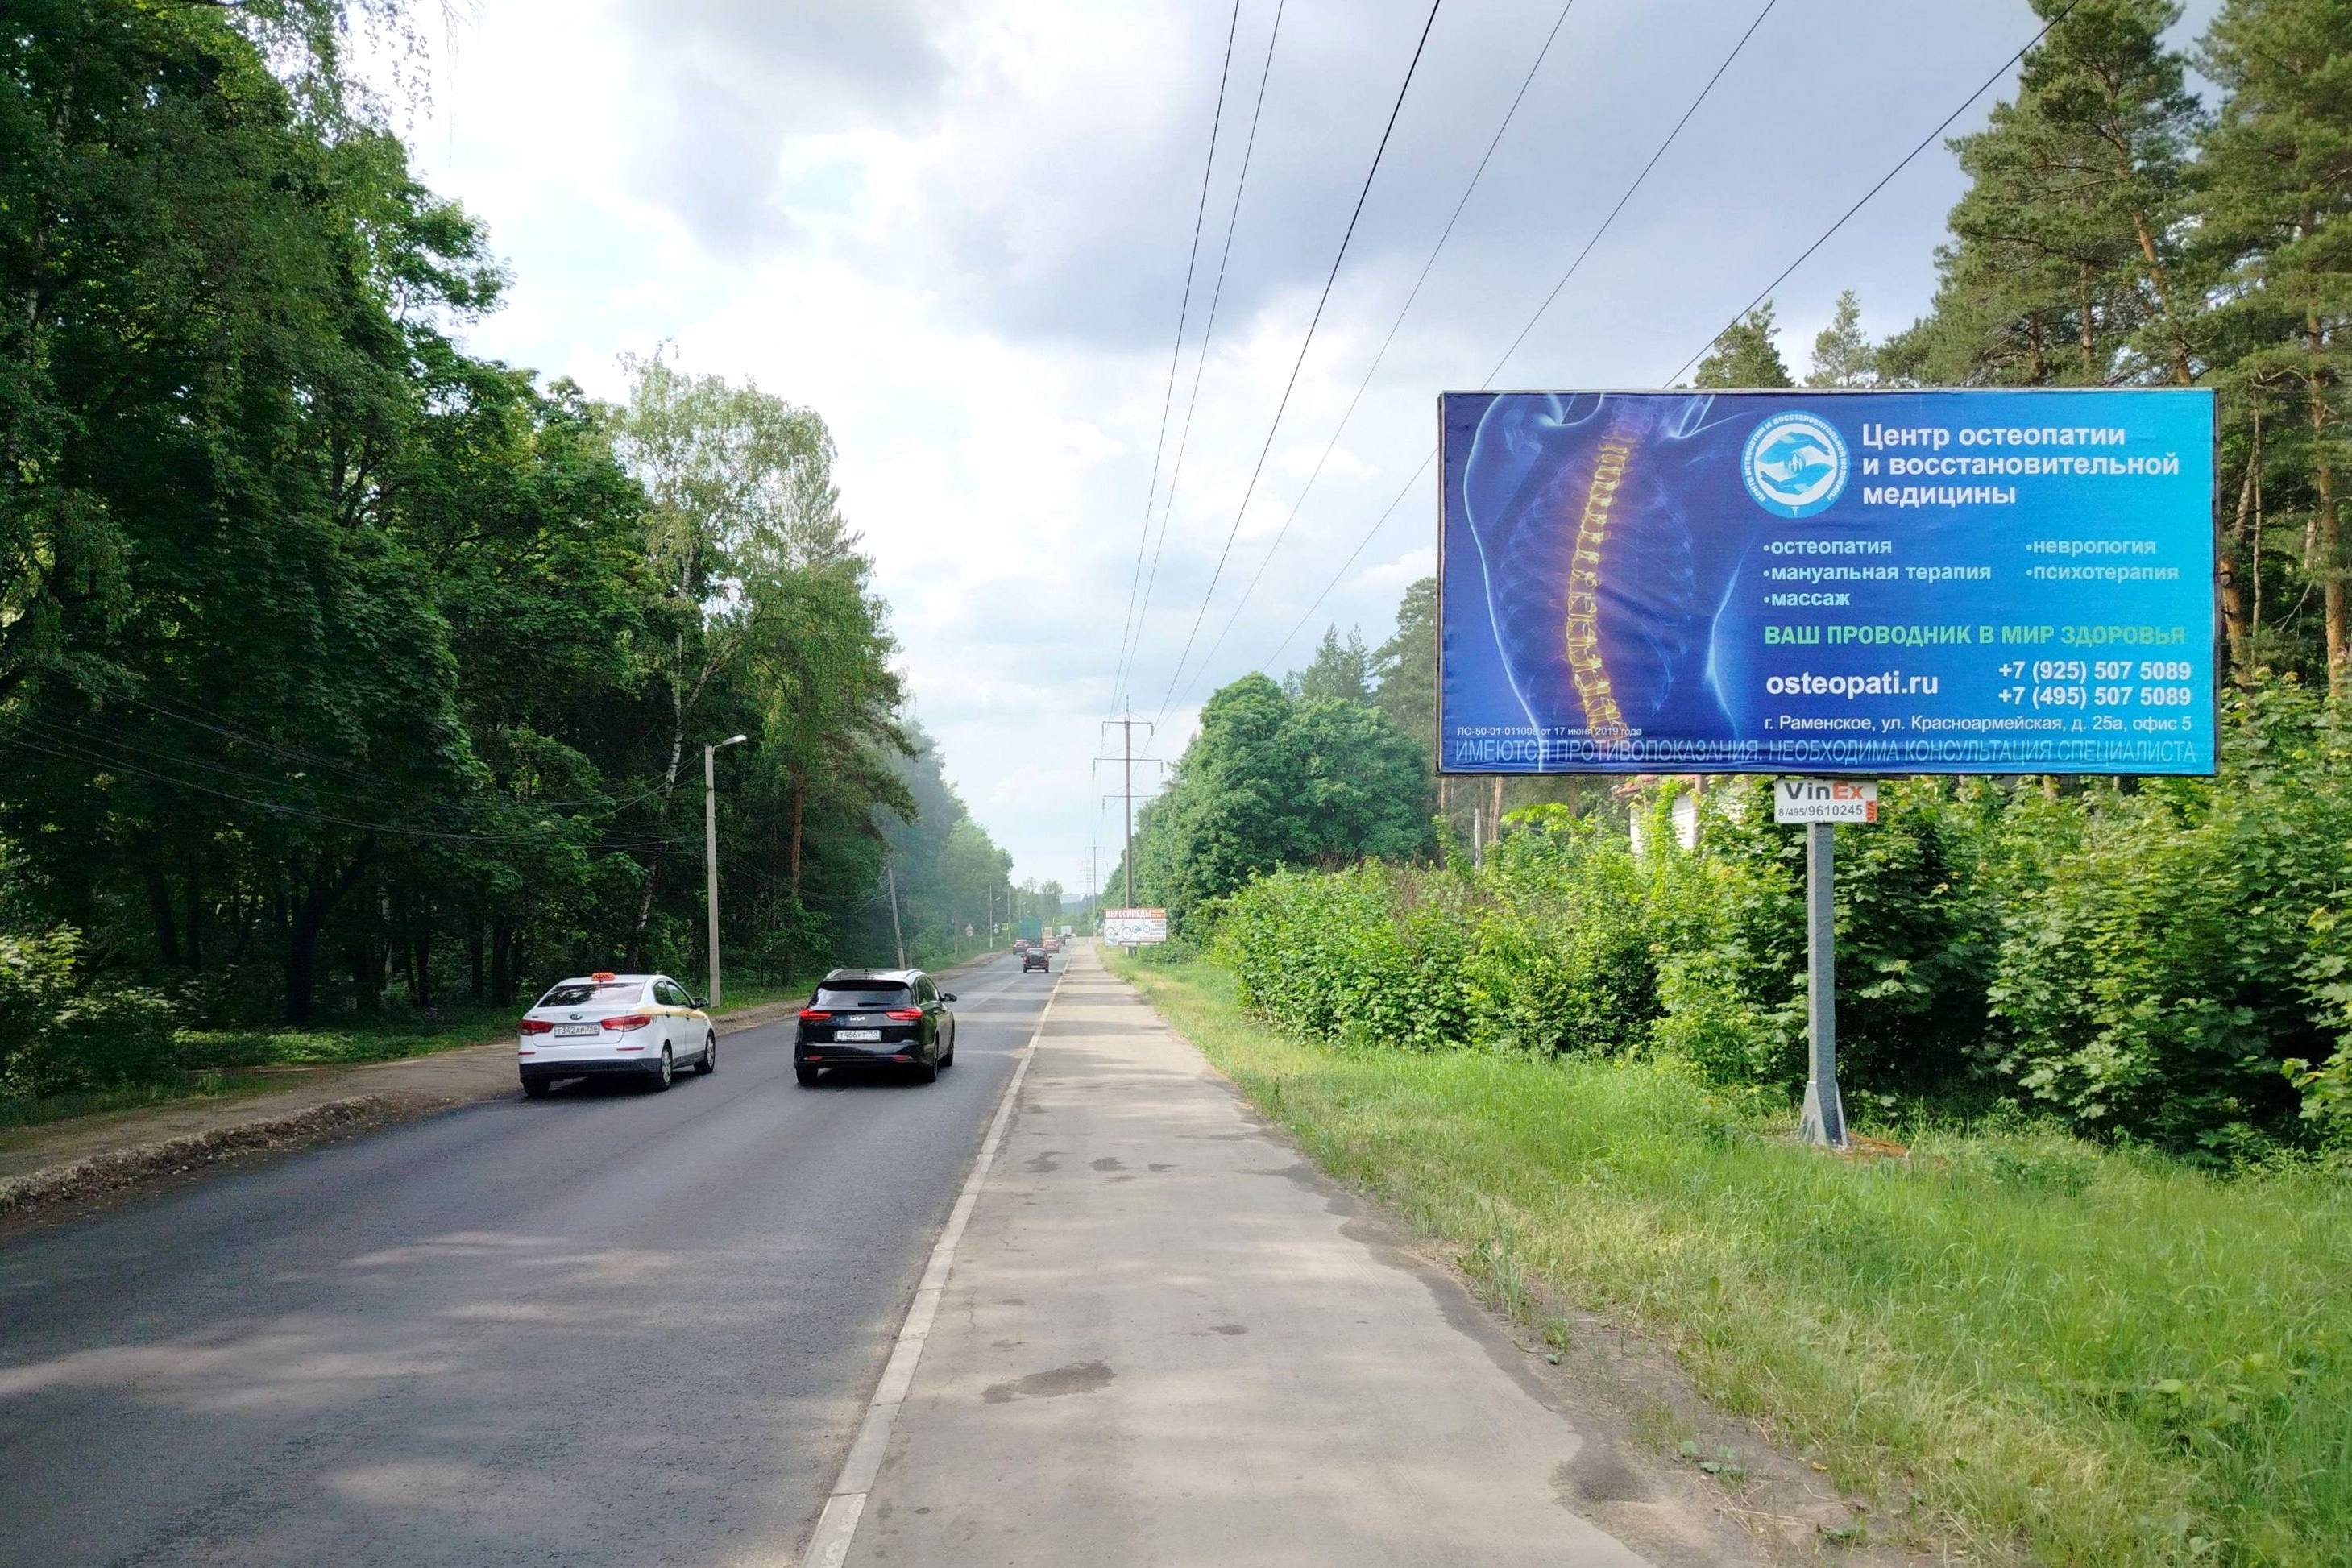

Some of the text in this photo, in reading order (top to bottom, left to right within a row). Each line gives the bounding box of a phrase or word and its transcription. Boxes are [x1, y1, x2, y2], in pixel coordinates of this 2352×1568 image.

[1863, 423, 2126, 451] Центр остеопатии
[1863, 451, 2180, 475] и восстановительной
[1863, 487, 2016, 508] медицины
[1771, 541, 1893, 554] остеопатия
[2033, 541, 2156, 558] неврология
[1771, 566, 1992, 584] мануальная терапия
[2033, 566, 2180, 584] психотерапия
[1771, 593, 1851, 606] массаж
[1765, 625, 2186, 647] ВАШ ПРОВОДНИК В МИР ЗДОРОВЬЯ
[1998, 661, 2192, 684] +7 (925) 507 5089
[1765, 670, 1939, 699] osteopati.ru
[1998, 687, 2192, 710] +7 (495) 507 5089
[1554, 727, 1565, 736] 17
[1595, 727, 1620, 736] 2019
[1621, 728, 1643, 737] года
[1765, 715, 2192, 734] г. Раменское, ул. Красноармейская, д. 25а, офис 5
[1455, 740, 2196, 766] ИМЕЮТСЯ ПРОТИВОПОКАЗАНИЯ. НЕОБХОДИМА КОНСУЛЬТАЦИЯ СПЕЦИАЛИСТА
[1784, 781, 1864, 800] VinEx
